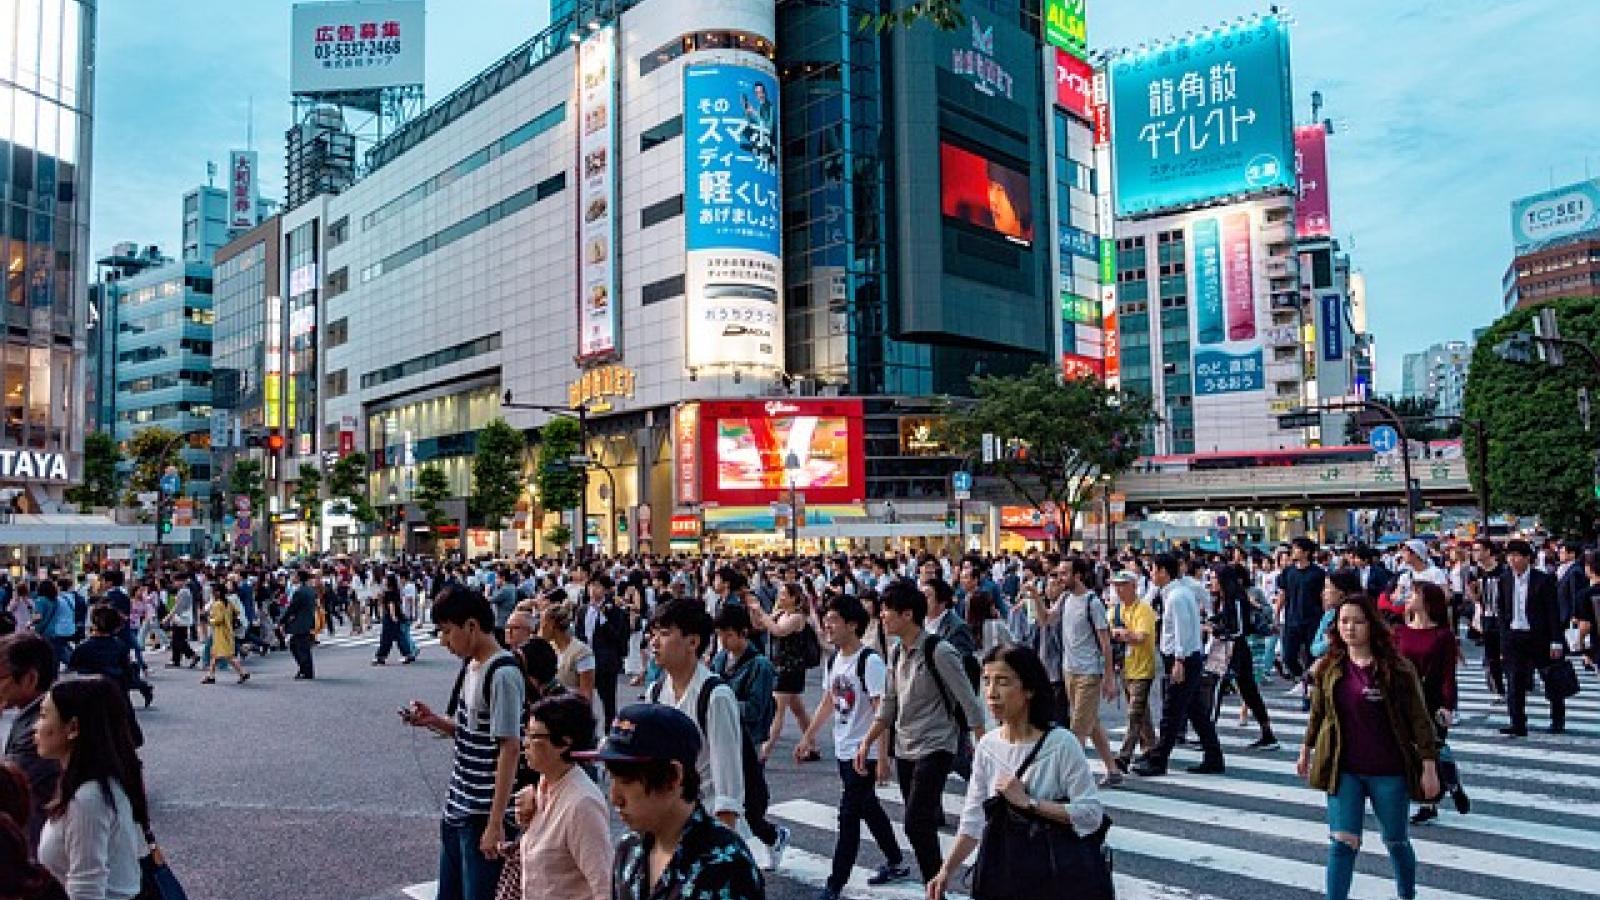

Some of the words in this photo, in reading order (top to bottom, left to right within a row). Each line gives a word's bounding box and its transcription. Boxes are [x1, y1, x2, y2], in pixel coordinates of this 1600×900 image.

[314, 21, 400, 42] 広告募集
[314, 40, 400, 59] 03-5337-2468
[1148, 61, 1237, 117] 龍角散
[698, 98, 729, 115] その
[698, 118, 771, 147] スマホ
[1138, 105, 1256, 159] ダイレクト
[699, 170, 777, 211] 軽くして
[699, 207, 776, 230] あげましょう
[1527, 199, 1583, 224] TOSEI
[0, 450, 68, 480] TAYA
